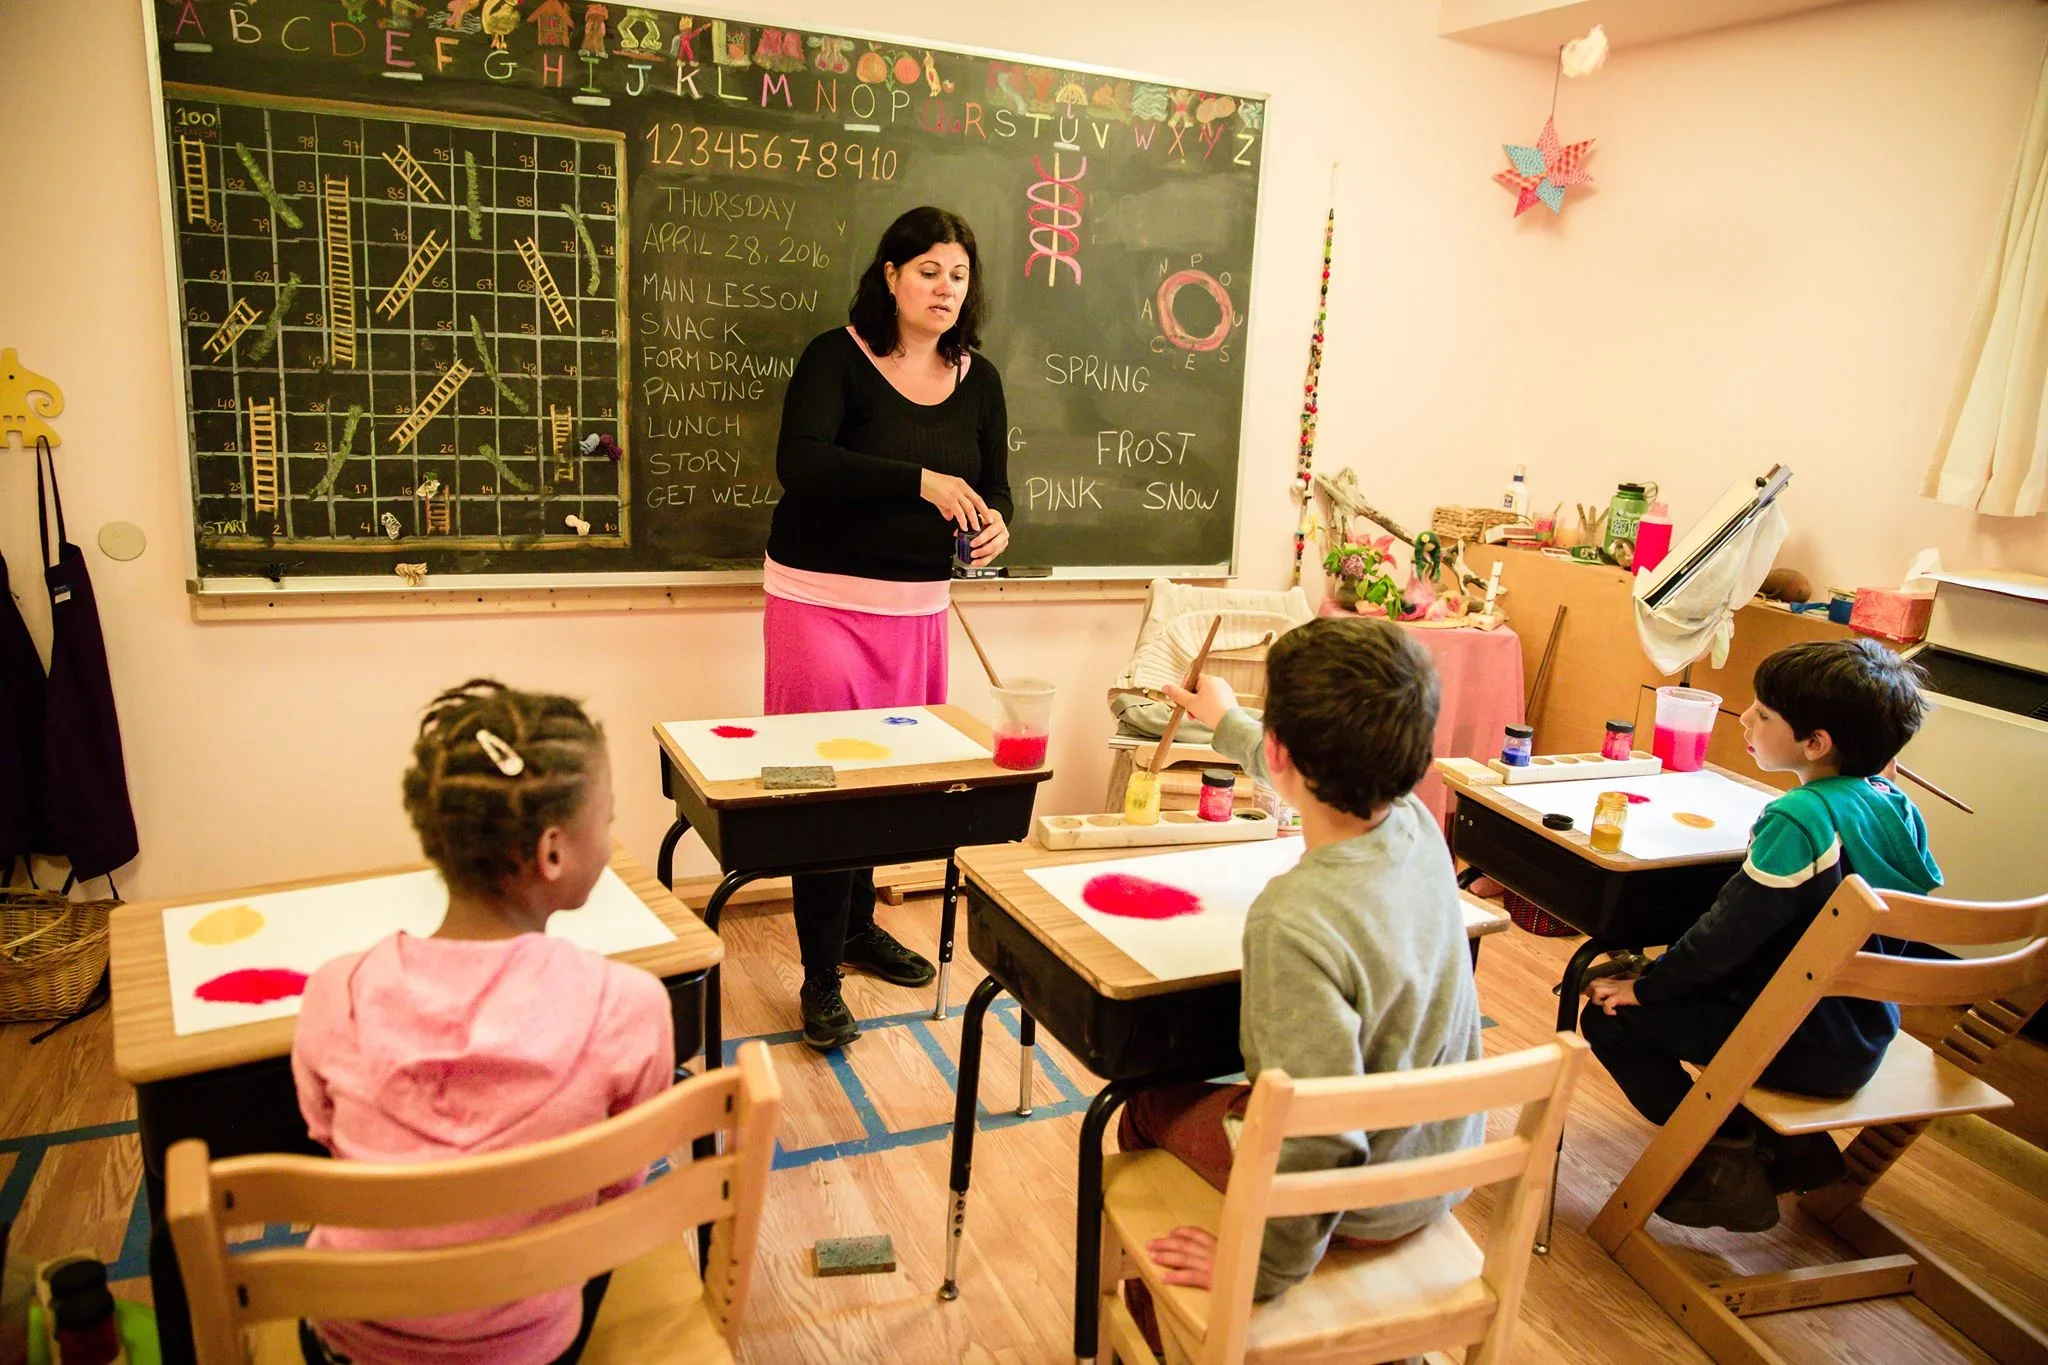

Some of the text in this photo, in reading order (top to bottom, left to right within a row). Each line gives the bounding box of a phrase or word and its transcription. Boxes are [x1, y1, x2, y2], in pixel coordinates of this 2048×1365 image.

[175, 0, 205, 37] A
[229, 8, 262, 44] B
[281, 16, 310, 51] C
[330, 21, 366, 56] D
[385, 30, 415, 68] E
[434, 36, 460, 72] F
[484, 50, 518, 80] G
[543, 54, 563, 88] H
[579, 56, 601, 93] I
[626, 64, 653, 97] J
[676, 66, 703, 99] K
[717, 65, 748, 101] L
[761, 73, 793, 108] M
[815, 79, 837, 113] N
[851, 84, 875, 118] O
[891, 90, 910, 123] P
[964, 102, 987, 139] R
[994, 109, 1017, 137] S
[1025, 112, 1054, 138] T
[1059, 117, 1078, 143] U
[1092, 122, 1110, 149] V
[1134, 125, 1156, 150] W
[1168, 125, 1187, 157] X
[1200, 123, 1226, 161] Y
[1233, 133, 1255, 166] Z
[175, 107, 216, 127] 100
[298, 136, 613, 176] 98 97 95 93 92 91
[226, 178, 245, 190] 82
[297, 180, 316, 193] 83
[387, 187, 406, 200] 85
[516, 195, 533, 208] 88
[658, 186, 796, 231] THURSDAY
[252, 218, 271, 233] 79
[393, 228, 408, 241] 76
[642, 222, 712, 255] APRIL
[209, 269, 536, 293] 61 62 66 67 68
[643, 272, 818, 312] MAIN LESSON
[188, 307, 210, 322] 60
[640, 312, 746, 346] SNACK
[643, 346, 701, 372] FORM
[1045, 354, 1151, 393] SPRING
[642, 376, 765, 406] PAINTING
[217, 399, 235, 410] 40
[478, 406, 493, 415] 34
[601, 408, 613, 418] 31
[648, 414, 740, 439] LUNCH
[224, 441, 236, 451] 21
[313, 442, 328, 451] 23
[440, 444, 454, 453] 26
[1098, 430, 1197, 468] FROST
[649, 449, 740, 478] STORY
[354, 484, 368, 494] 17
[401, 486, 413, 496] 16
[481, 485, 493, 494] 14
[646, 484, 780, 509] GET WELL
[1025, 476, 1103, 511] PINK
[1142, 480, 1219, 511] SNOW
[203, 520, 248, 536] START
[272, 521, 618, 535] 2 4 10
